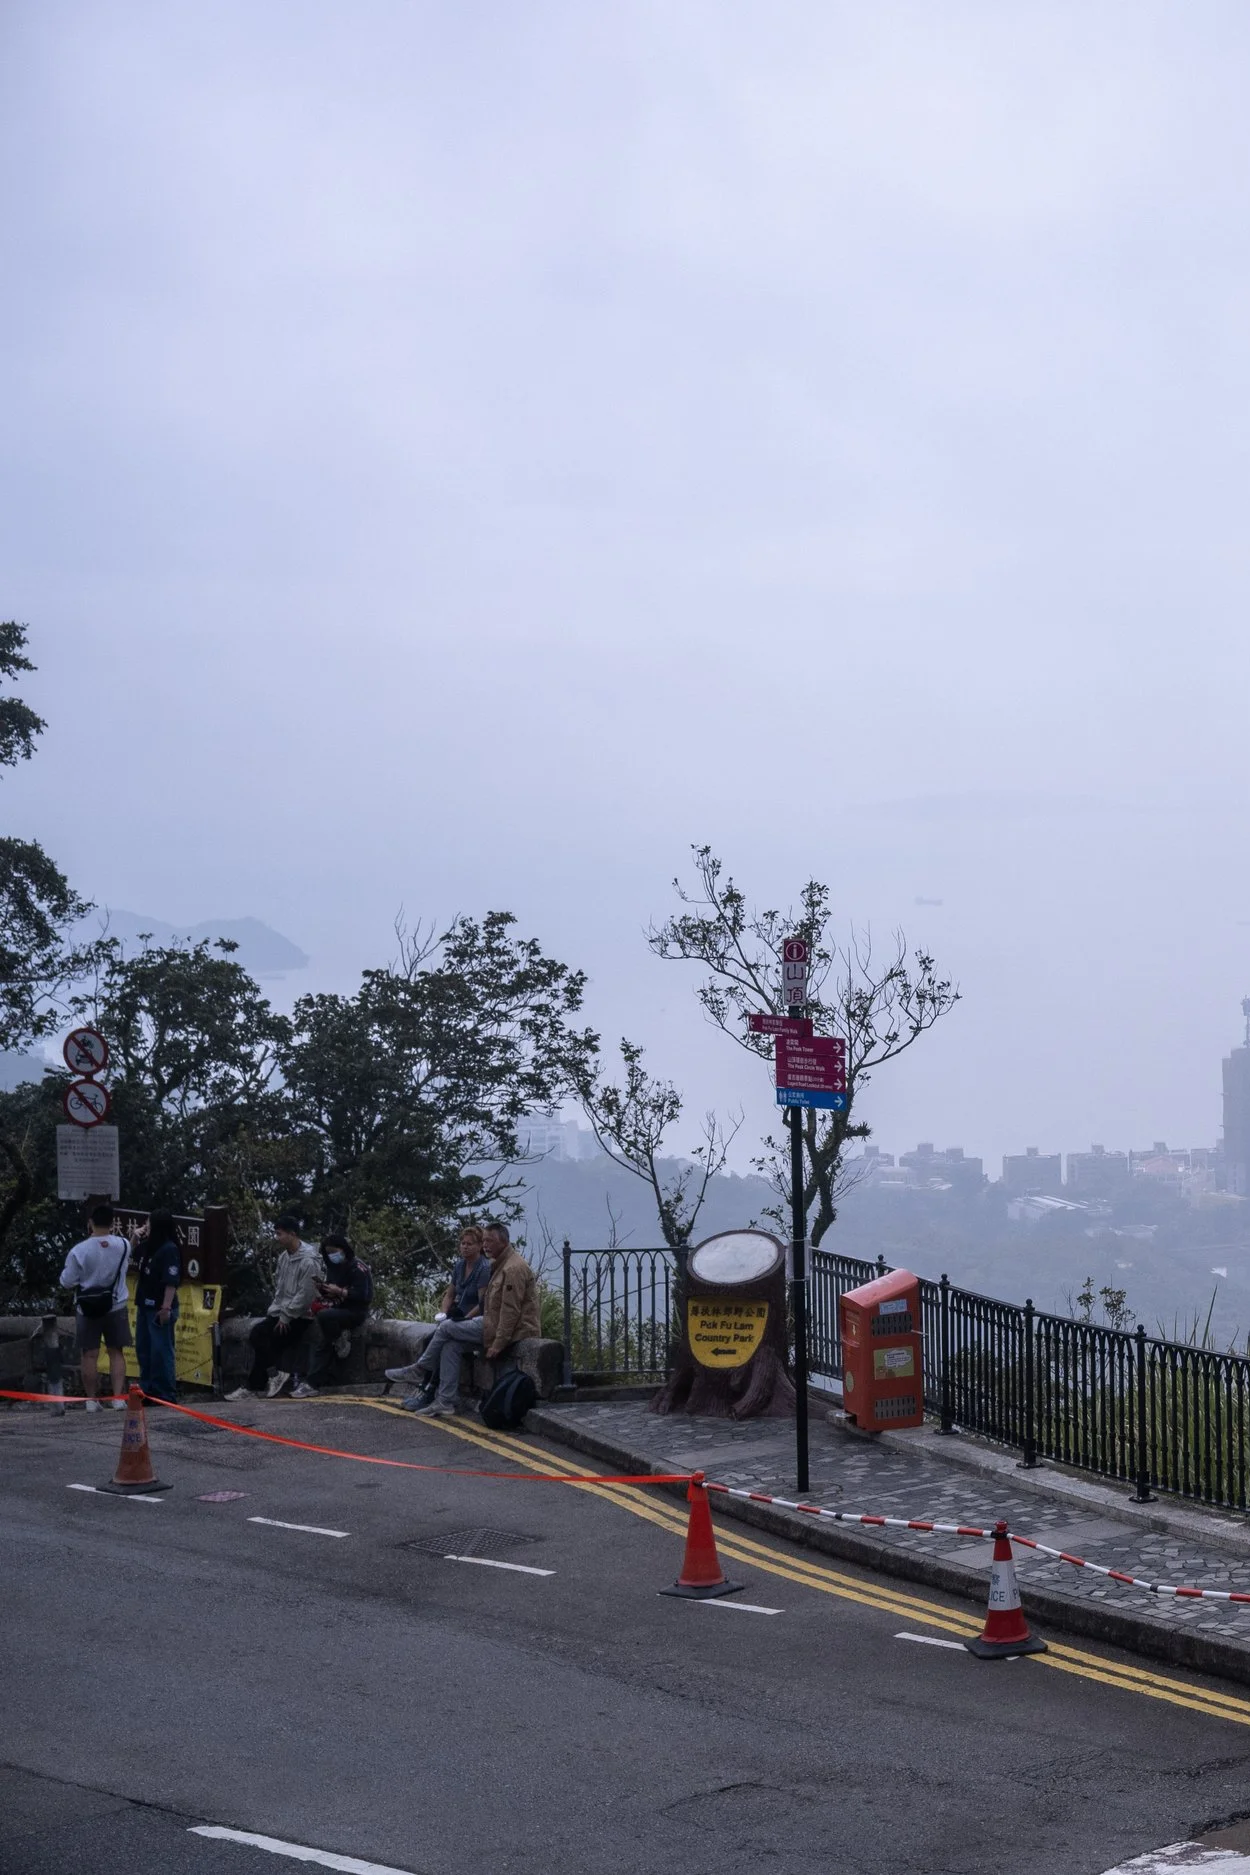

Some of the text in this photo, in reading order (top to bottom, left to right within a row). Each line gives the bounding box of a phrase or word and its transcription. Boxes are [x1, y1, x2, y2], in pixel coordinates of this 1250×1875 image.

[786, 963, 804, 1005] 山頂
[720, 1321, 732, 1330] Fu
[734, 1322, 754, 1330] Lam
[694, 1333, 754, 1344] Country Park
